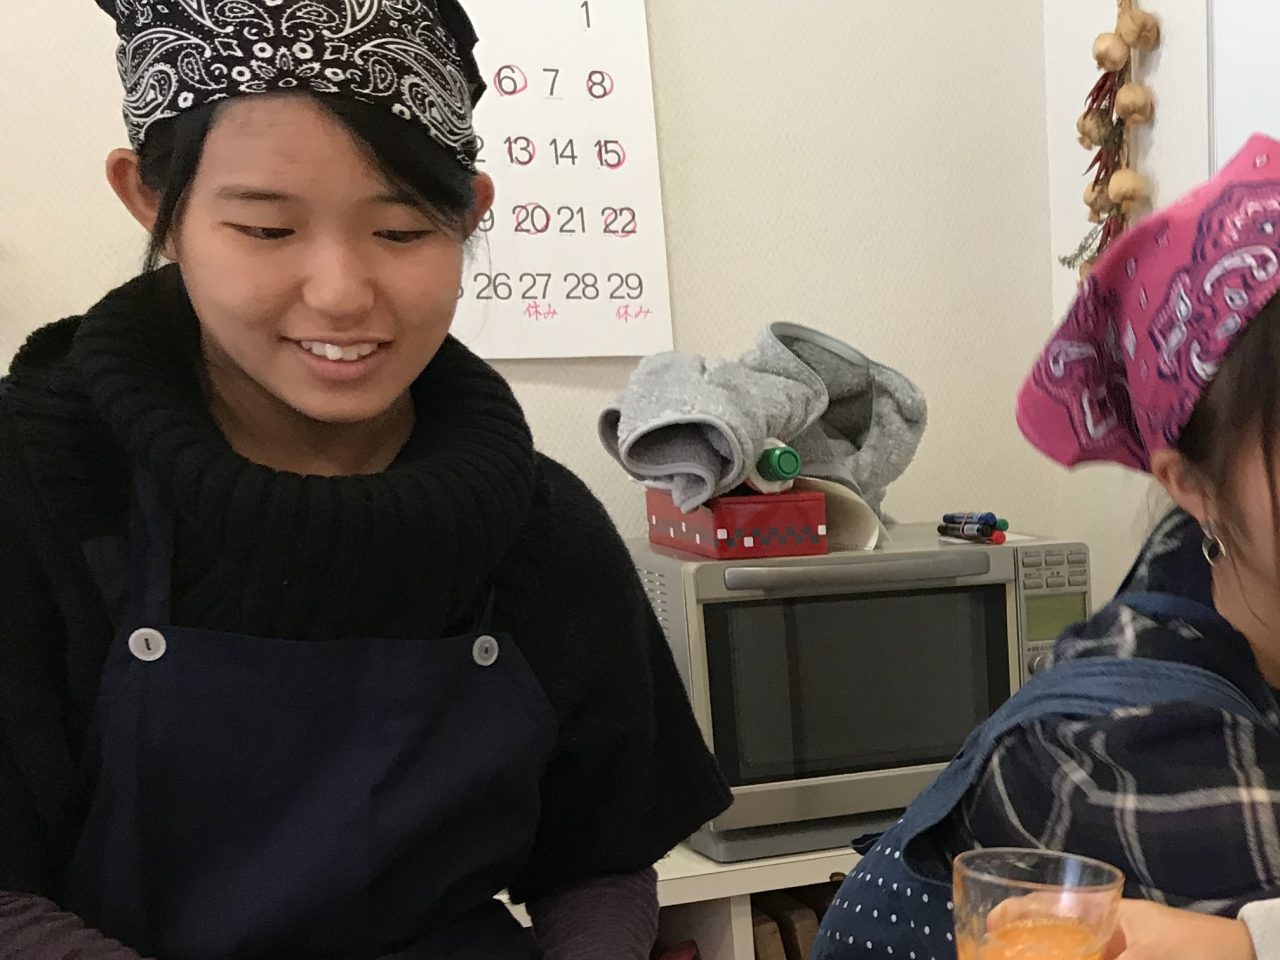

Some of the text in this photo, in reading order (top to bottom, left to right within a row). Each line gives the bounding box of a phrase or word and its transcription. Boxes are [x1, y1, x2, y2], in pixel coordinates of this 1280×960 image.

[581, 0, 590, 28] 1
[497, 66, 607, 99] 6 7 8
[504, 136, 533, 165] 13
[550, 138, 577, 166] 14
[595, 139, 622, 168] 15
[512, 204, 550, 233] 20
[557, 206, 586, 233] 21
[601, 207, 637, 234] 22
[473, 272, 513, 300] 26
[519, 272, 552, 300] 27
[564, 272, 600, 300] 28
[607, 273, 644, 300] 29
[523, 301, 558, 322] 休み
[616, 301, 654, 322] 休み
